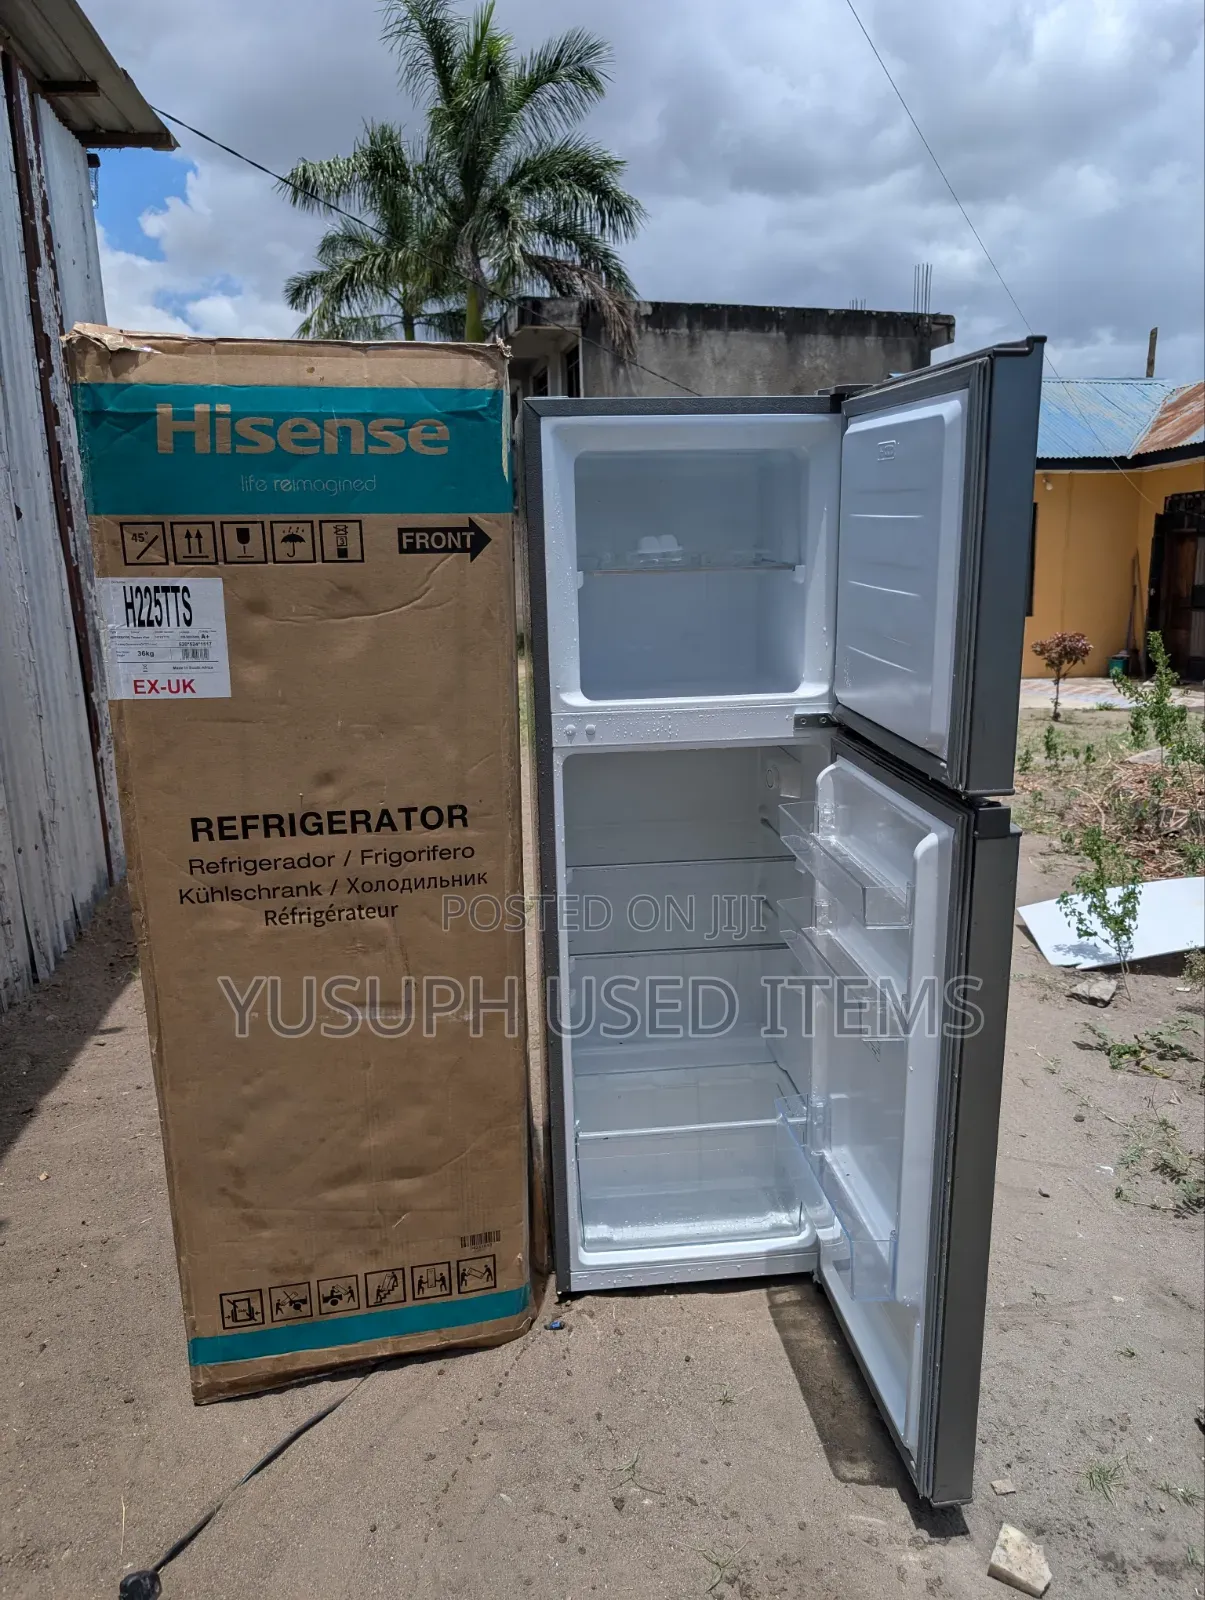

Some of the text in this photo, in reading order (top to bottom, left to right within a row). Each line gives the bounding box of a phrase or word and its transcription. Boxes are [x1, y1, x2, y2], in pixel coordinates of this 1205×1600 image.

[156, 403, 450, 456] Hisense
[240, 475, 377, 496] life reimagined
[402, 530, 476, 551] FRONT
[123, 585, 193, 628] H225TTS
[137, 650, 155, 658] 36kg
[133, 678, 196, 695] EX-UK
[190, 804, 469, 842] REFRIGERATOR
[189, 853, 336, 876] Refrigerador
[360, 845, 475, 867] Frigorifero
[178, 881, 323, 905] Kühlschrank
[347, 871, 488, 894] Холодильник
[264, 903, 399, 928] Réfrigérateur
